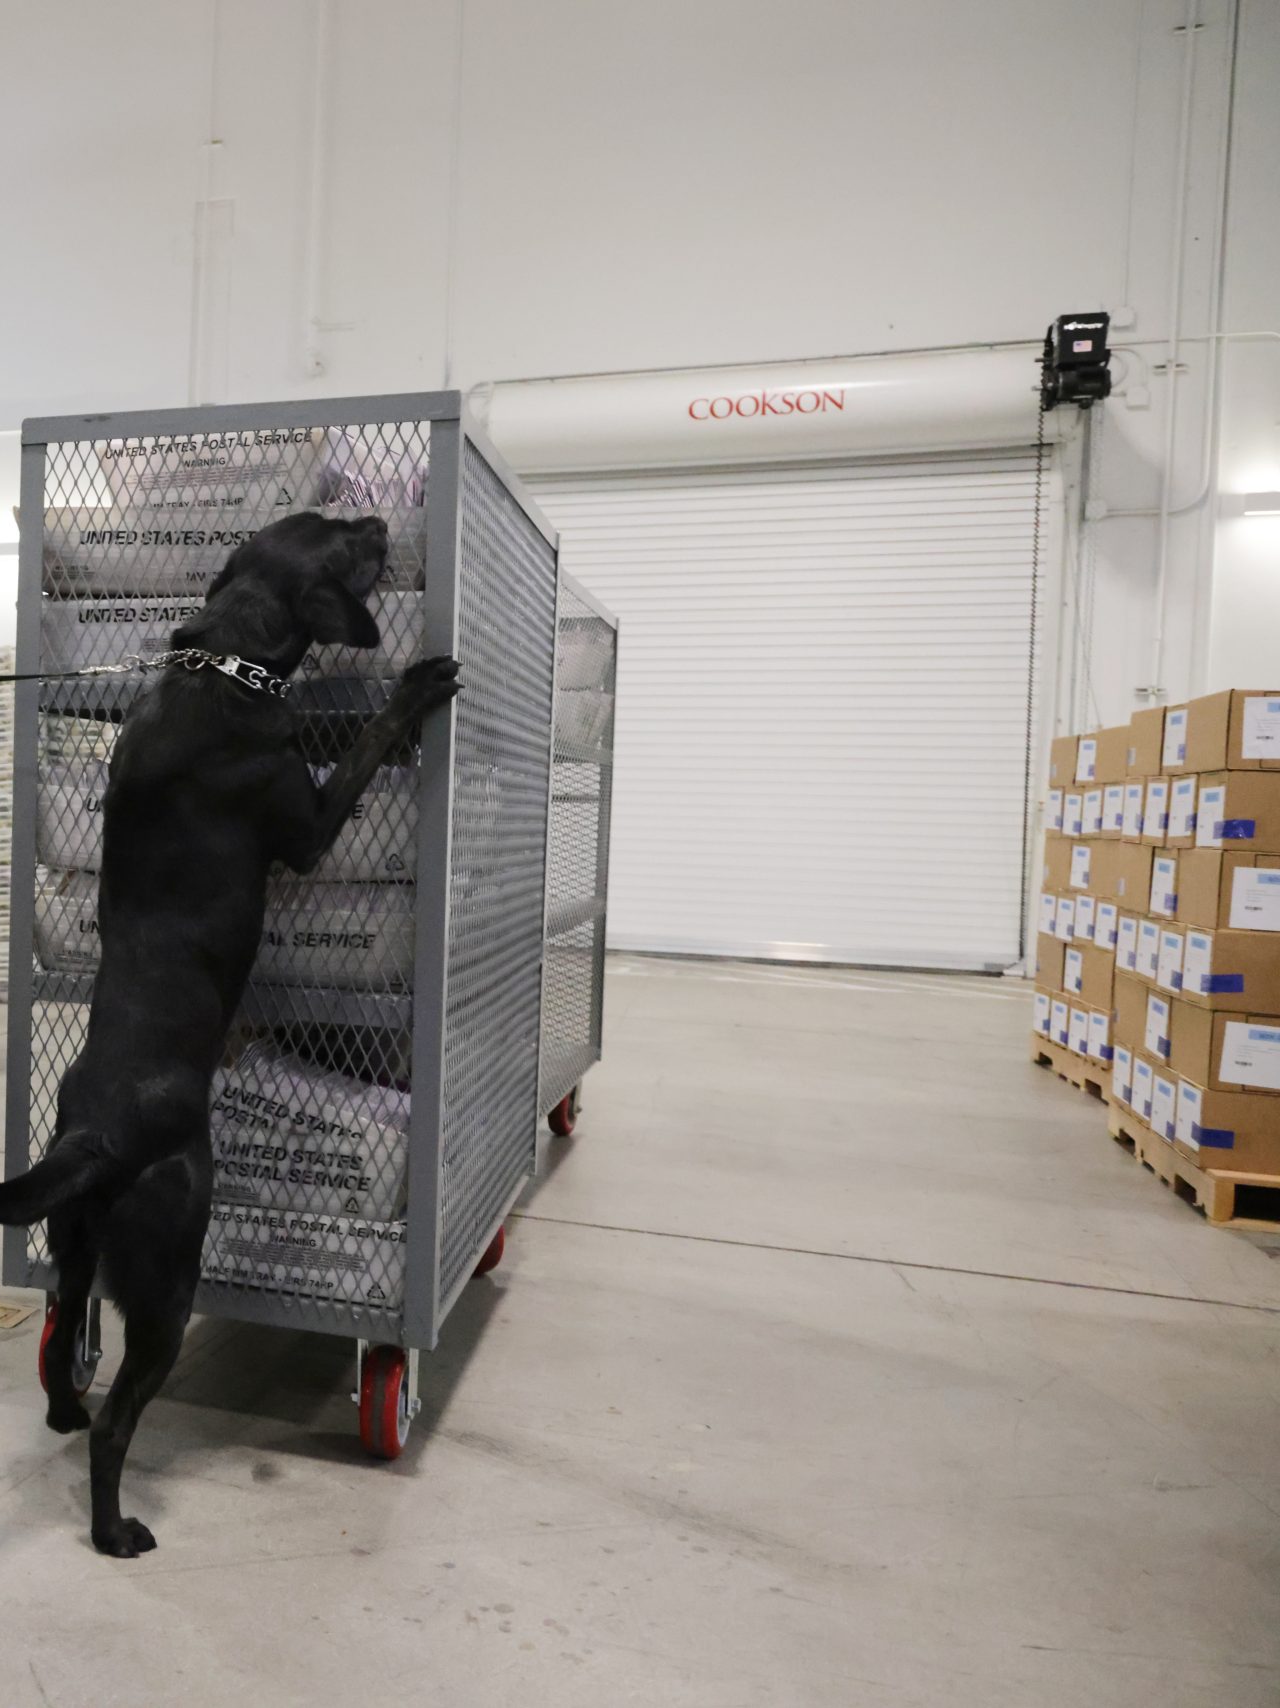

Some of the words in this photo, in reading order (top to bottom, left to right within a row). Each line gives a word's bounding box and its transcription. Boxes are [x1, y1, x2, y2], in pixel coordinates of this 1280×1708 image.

[688, 390, 844, 420] COOKSON
[105, 446, 146, 459] UNITED
[152, 442, 197, 455] STATES
[255, 433, 312, 446] SERVICE
[80, 531, 138, 545] UNITED
[142, 531, 205, 546] STATES
[209, 531, 257, 546] POST
[78, 608, 136, 623] UNITED
[139, 607, 201, 622] STATES
[293, 933, 376, 948] SERVICE
[212, 1101, 274, 1129] POSTA
[223, 1085, 289, 1119] UNITED
[220, 1141, 286, 1162] UNITED
[292, 1150, 363, 1171] STATES
[214, 1159, 283, 1181] POSTAL
[288, 1169, 370, 1191] SERVICE
[236, 1213, 285, 1229] STATES
[290, 1219, 343, 1235] POSTAL
